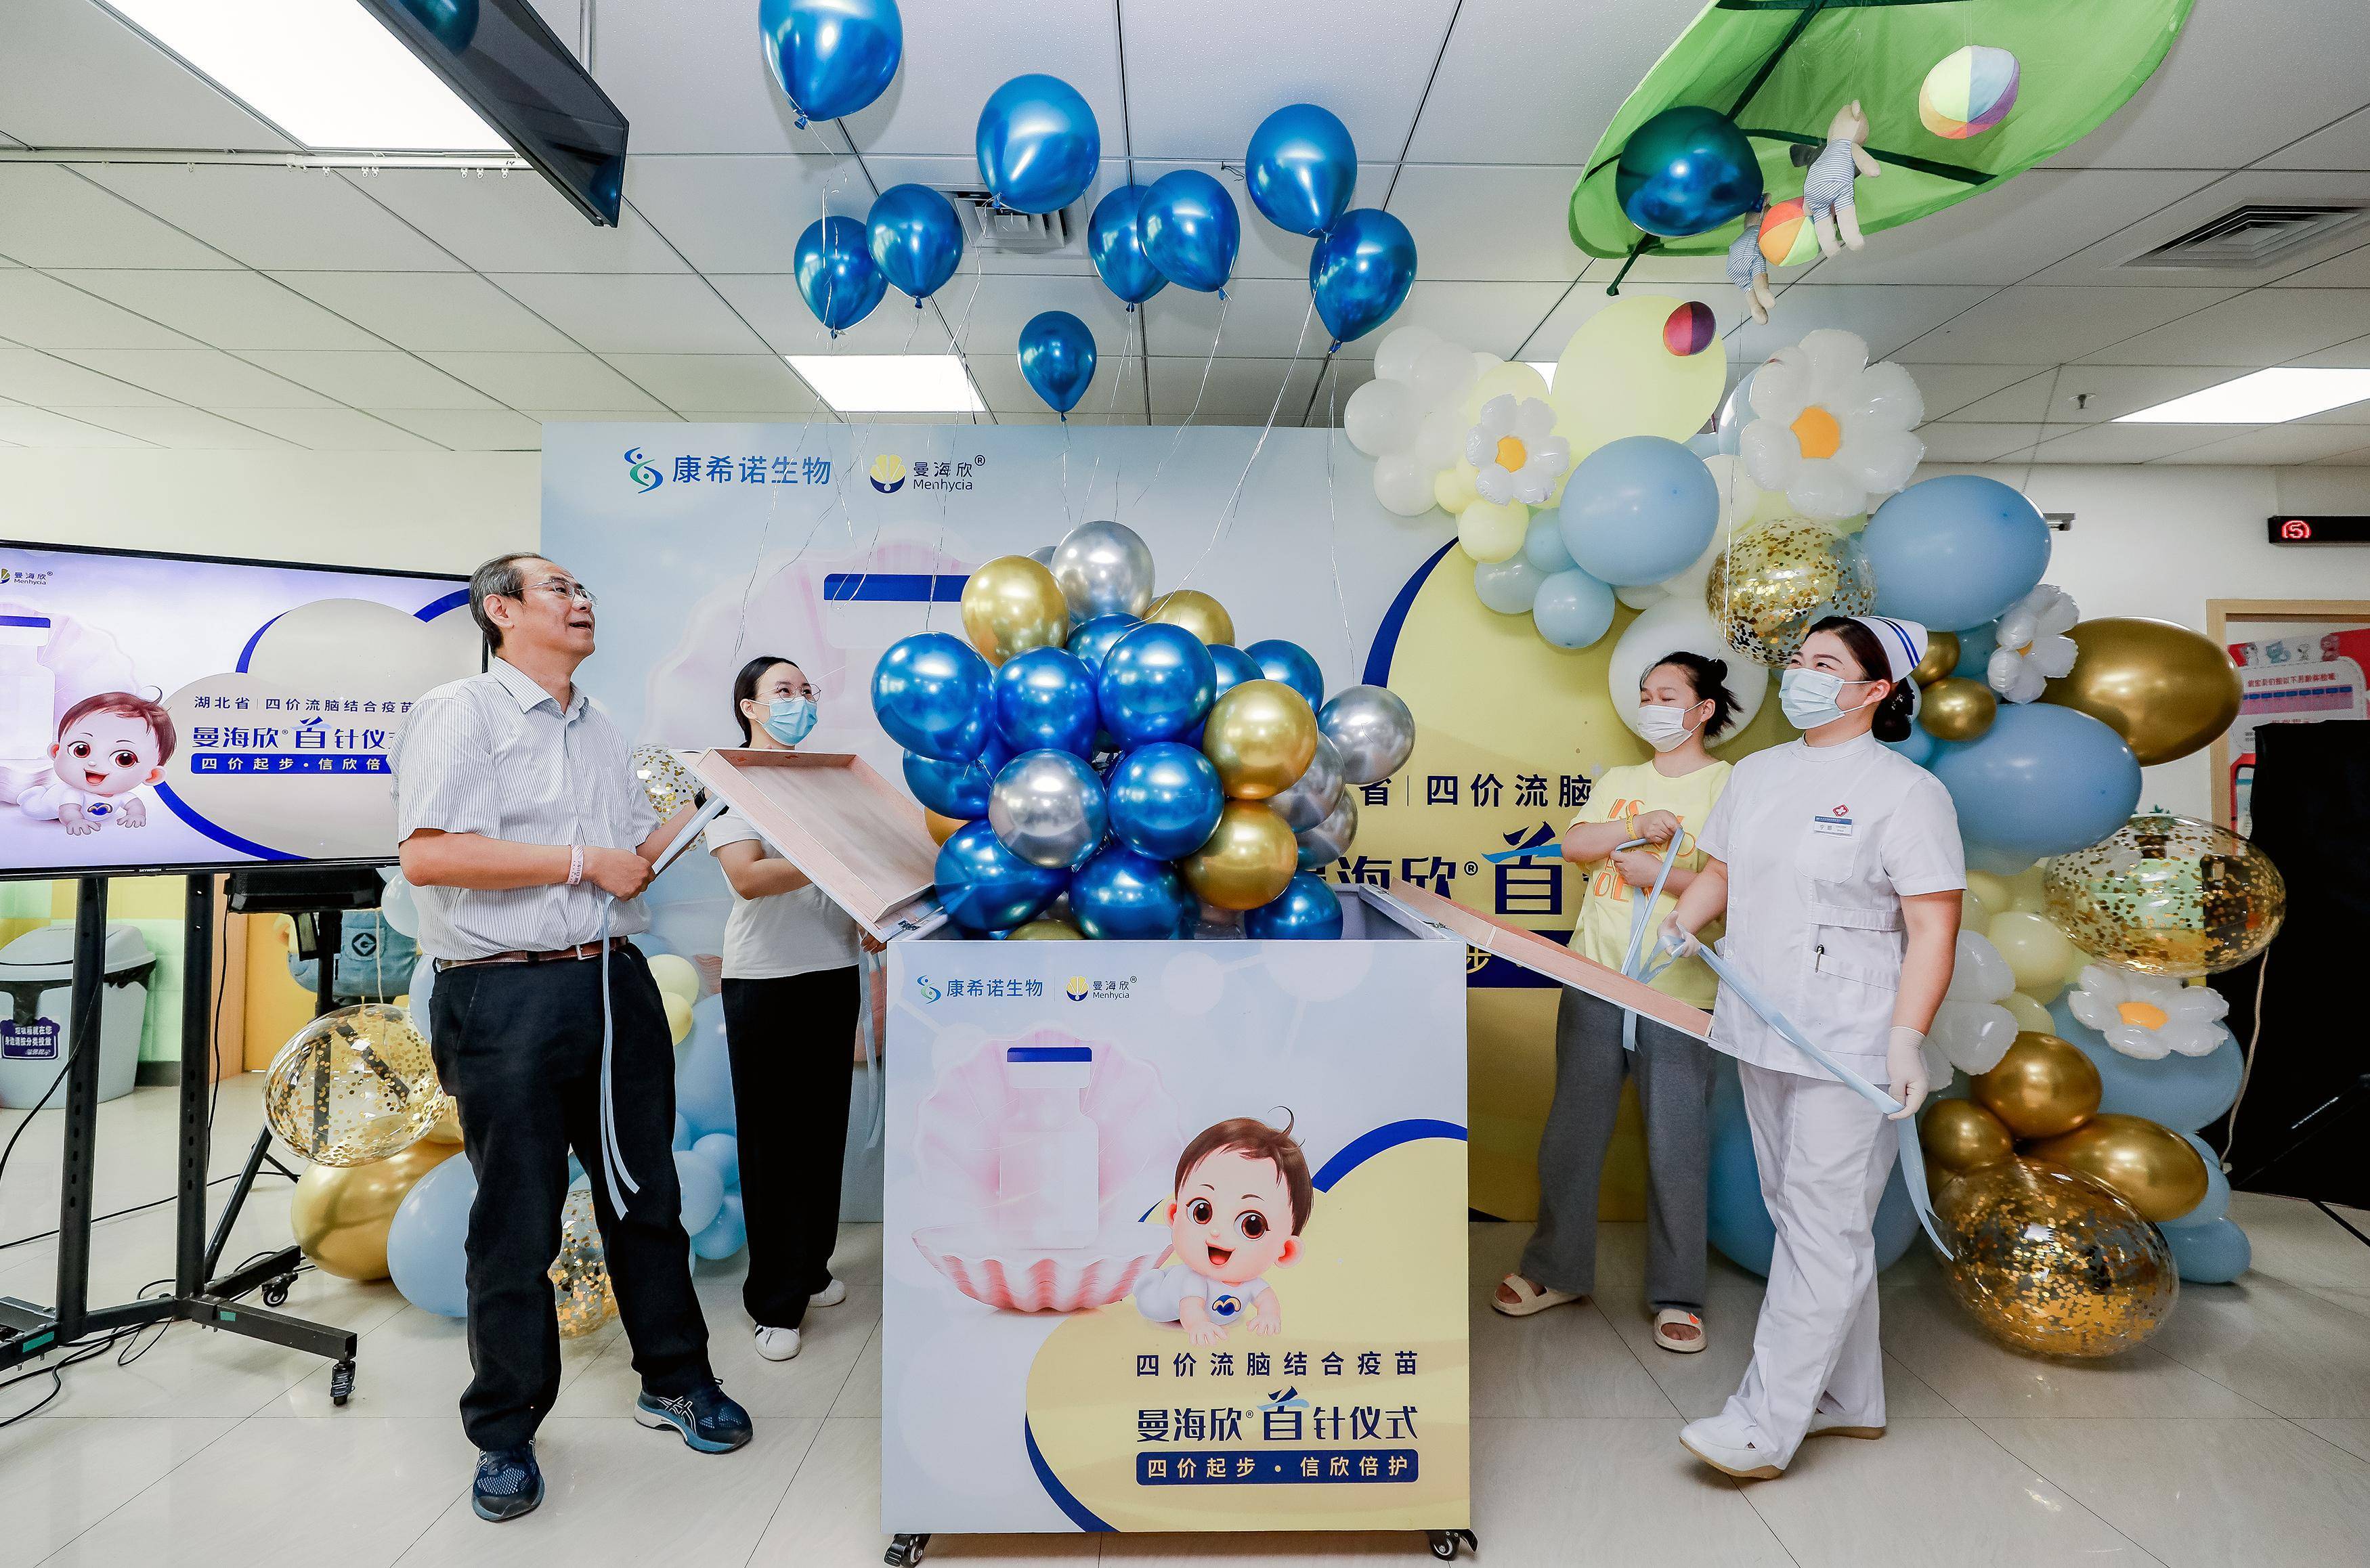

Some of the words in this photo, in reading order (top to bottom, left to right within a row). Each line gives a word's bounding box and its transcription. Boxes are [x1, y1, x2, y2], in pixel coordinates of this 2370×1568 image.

[672, 455, 832, 484] 康希诺生物
[913, 479, 973, 492] Menhycia
[194, 695, 251, 710] 湖北省
[1426, 773, 1592, 808] 四价流脑
[946, 978, 1043, 998] 康希诺生物
[1092, 991, 1130, 1001] Menhycia
[1136, 1350, 1419, 1378] 四价流脑结合疫苗
